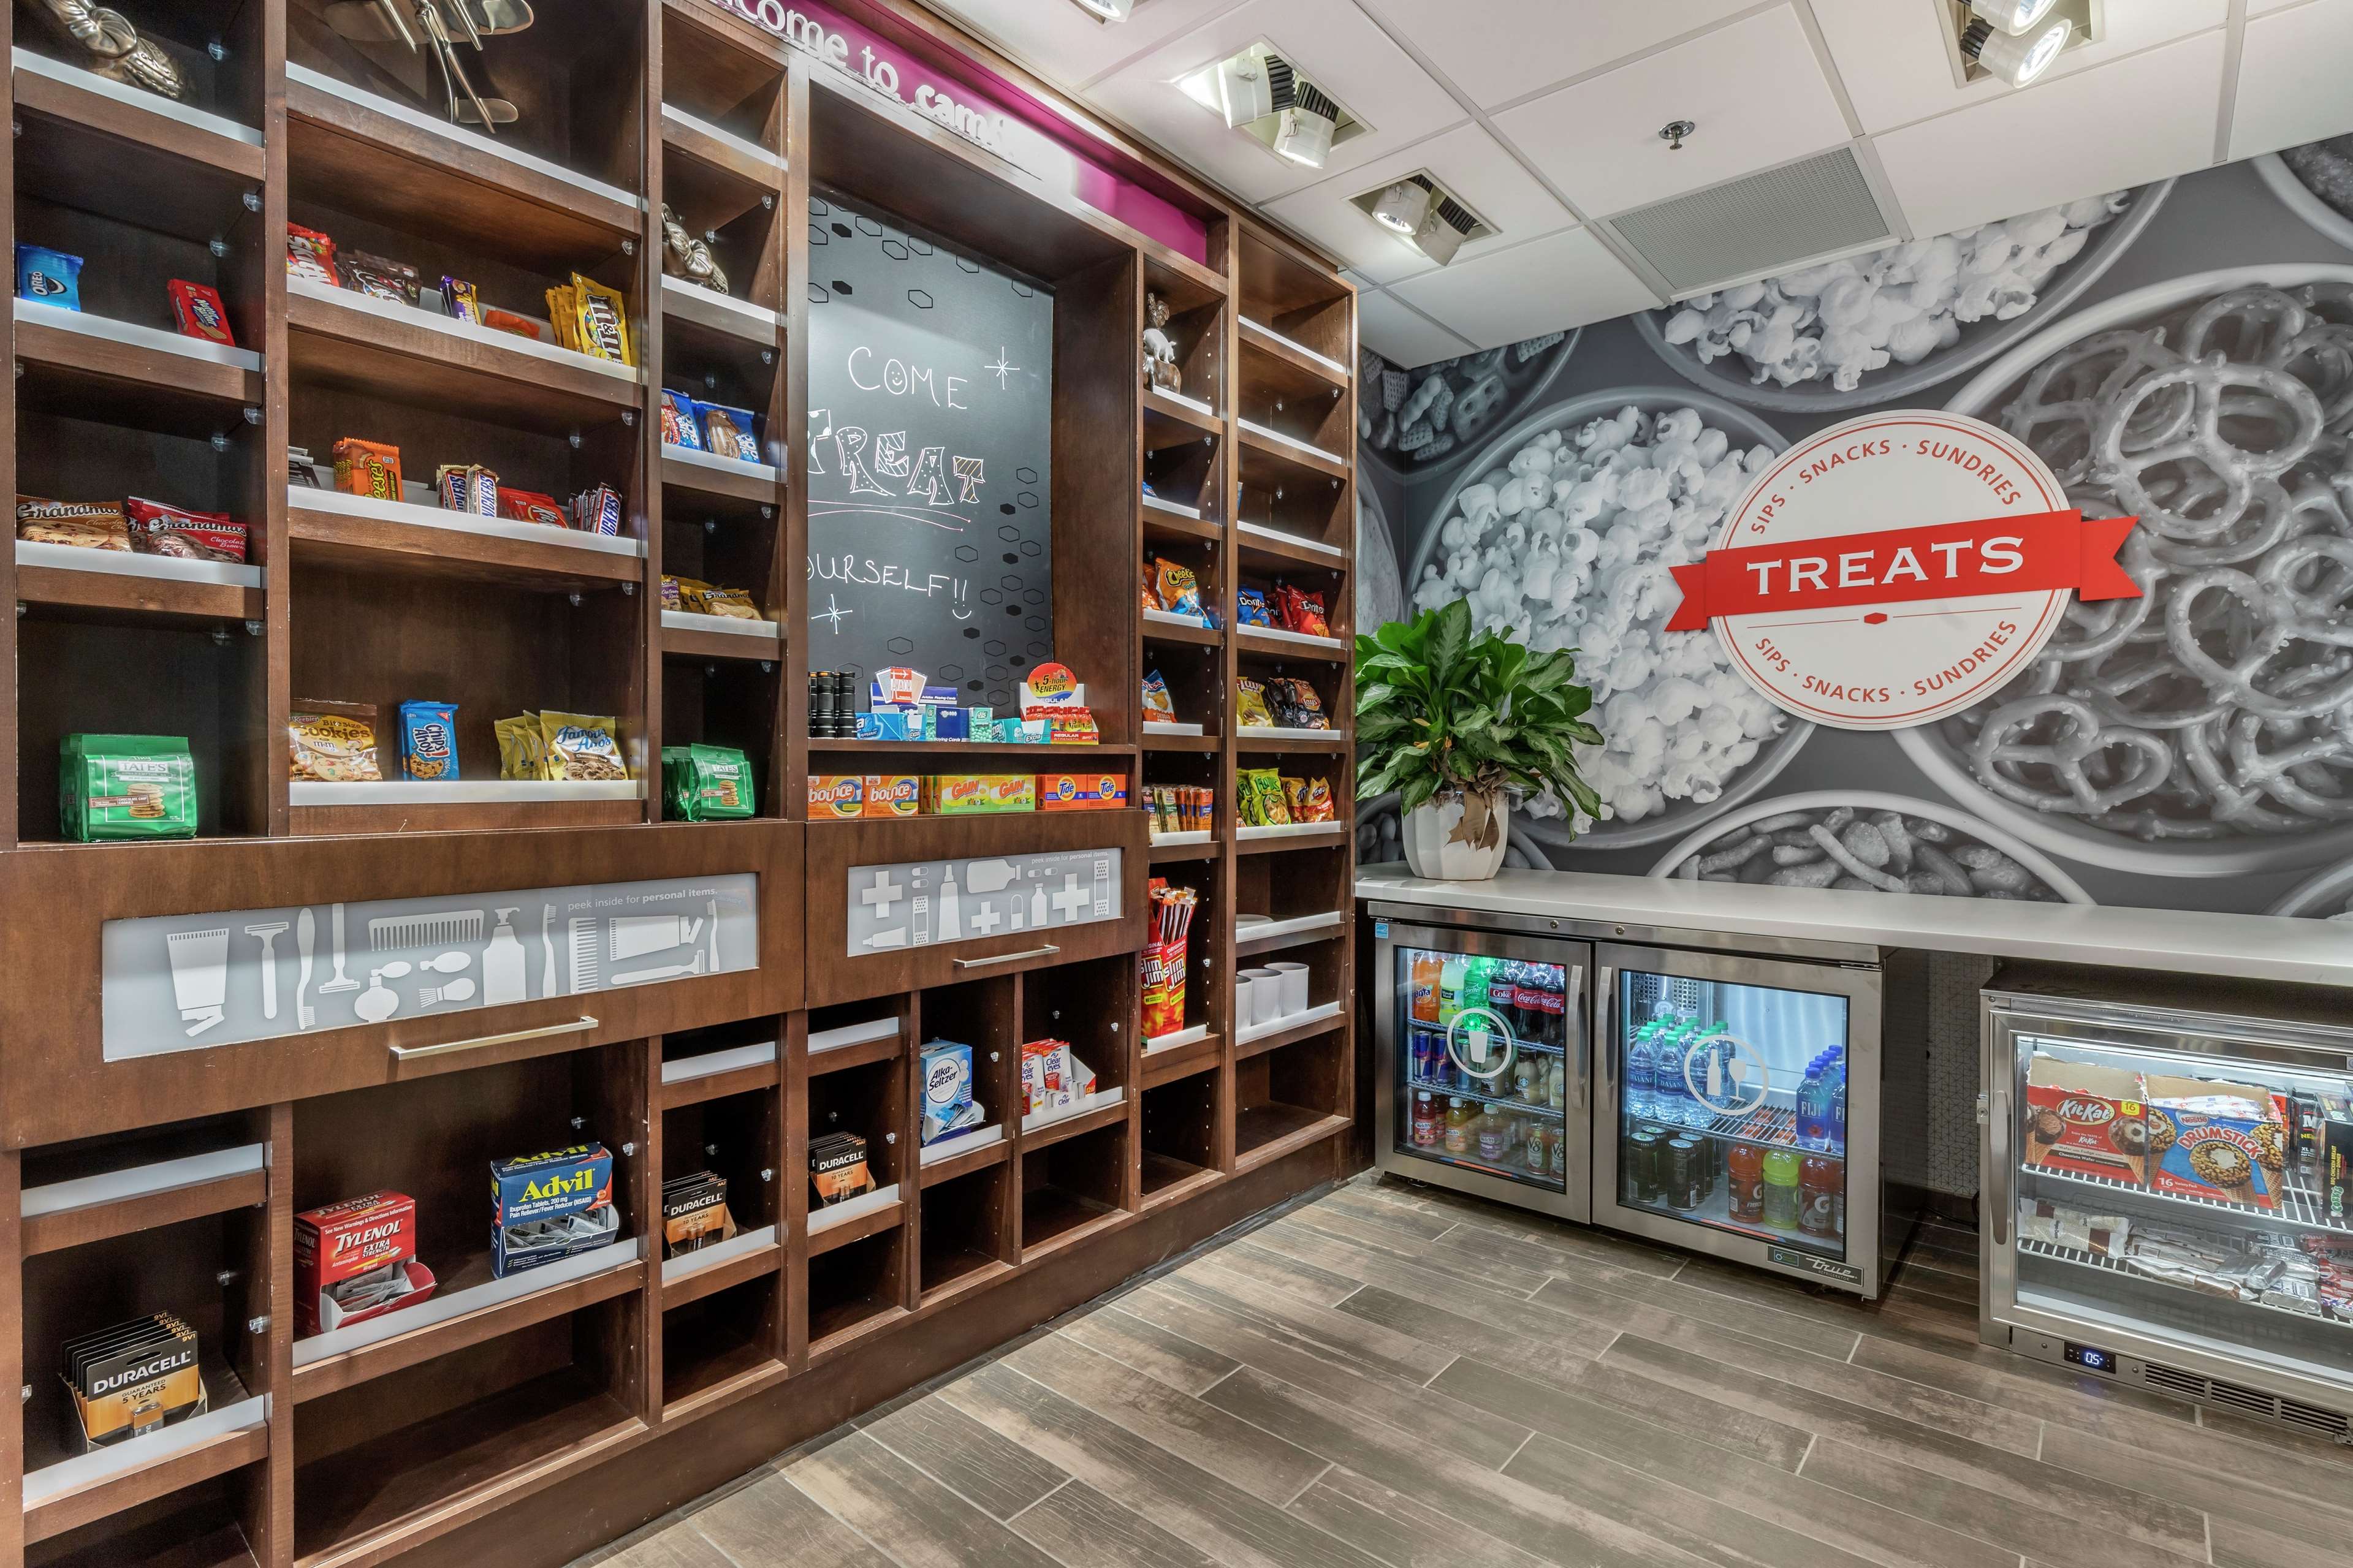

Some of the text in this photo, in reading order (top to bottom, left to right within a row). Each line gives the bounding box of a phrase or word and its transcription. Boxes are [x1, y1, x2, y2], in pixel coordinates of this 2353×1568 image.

[862, 45, 900, 94] to
[32, 271, 49, 295] OREO
[848, 346, 967, 409] COME
[1751, 439, 2021, 534] SIPS SNACKS SUNDRIES
[481, 475, 495, 517] NICKERS
[1747, 537, 2023, 595] TREATS
[1755, 621, 2017, 703] SIPS SNACKS SUNDRIES
[892, 680, 911, 691] AVIATOR
[1040, 684, 1066, 693] ENERGY
[557, 725, 607, 743] Famous
[122, 763, 166, 772] TATE'S
[808, 784, 854, 803] bounce
[870, 784, 911, 802] bounce
[1059, 782, 1074, 797] Tide
[1101, 781, 1114, 796] Tide
[568, 888, 717, 911] peek inside for personal items.
[1167, 940, 1186, 953] ORIGINAL
[1492, 990, 1511, 998] Coke
[1046, 1057, 1061, 1066] Clear
[1047, 1063, 1060, 1072] eyes
[929, 1071, 957, 1091] Seltzer
[930, 1067, 953, 1081] Alka-
[1801, 1101, 1821, 1117] FIJI
[2061, 1099, 2112, 1122] KitKat
[1529, 1137, 1541, 1152] V8
[1553, 1142, 1564, 1159] V8
[2178, 1127, 2265, 1159] DRUMSTICK
[507, 1145, 589, 1166] Advil
[819, 1151, 864, 1171] DURACELL
[519, 1168, 593, 1203] Advil
[2159, 1177, 2173, 1186] 16
[313, 1193, 384, 1216] TYLENOL
[510, 1203, 531, 1213] Ibuprofen
[532, 1200, 550, 1209] Tablets,
[520, 1204, 554, 1217] Reliever/Fever
[554, 1200, 573, 1210] Reducer
[573, 1196, 591, 1207] (NSAID)
[671, 1193, 723, 1216] DURACELL
[1814, 1195, 1830, 1213] G
[344, 1219, 365, 1230] Warnings
[369, 1211, 389, 1222] Directions
[389, 1205, 412, 1216] Information
[691, 1213, 709, 1222] YEARS
[294, 1227, 316, 1249] TYLENOL
[335, 1220, 401, 1253] TYLENOL
[362, 1245, 390, 1259] STRENGTH
[363, 1238, 390, 1254] EXTRA
[1806, 1258, 1855, 1279] true
[1818, 1270, 1850, 1282] REFRIGERATOR
[182, 1333, 196, 1342] 9V1
[94, 1350, 191, 1395] DURACELL
[122, 1379, 165, 1397] GUARANTEED
[132, 1385, 166, 1400] YEARS
